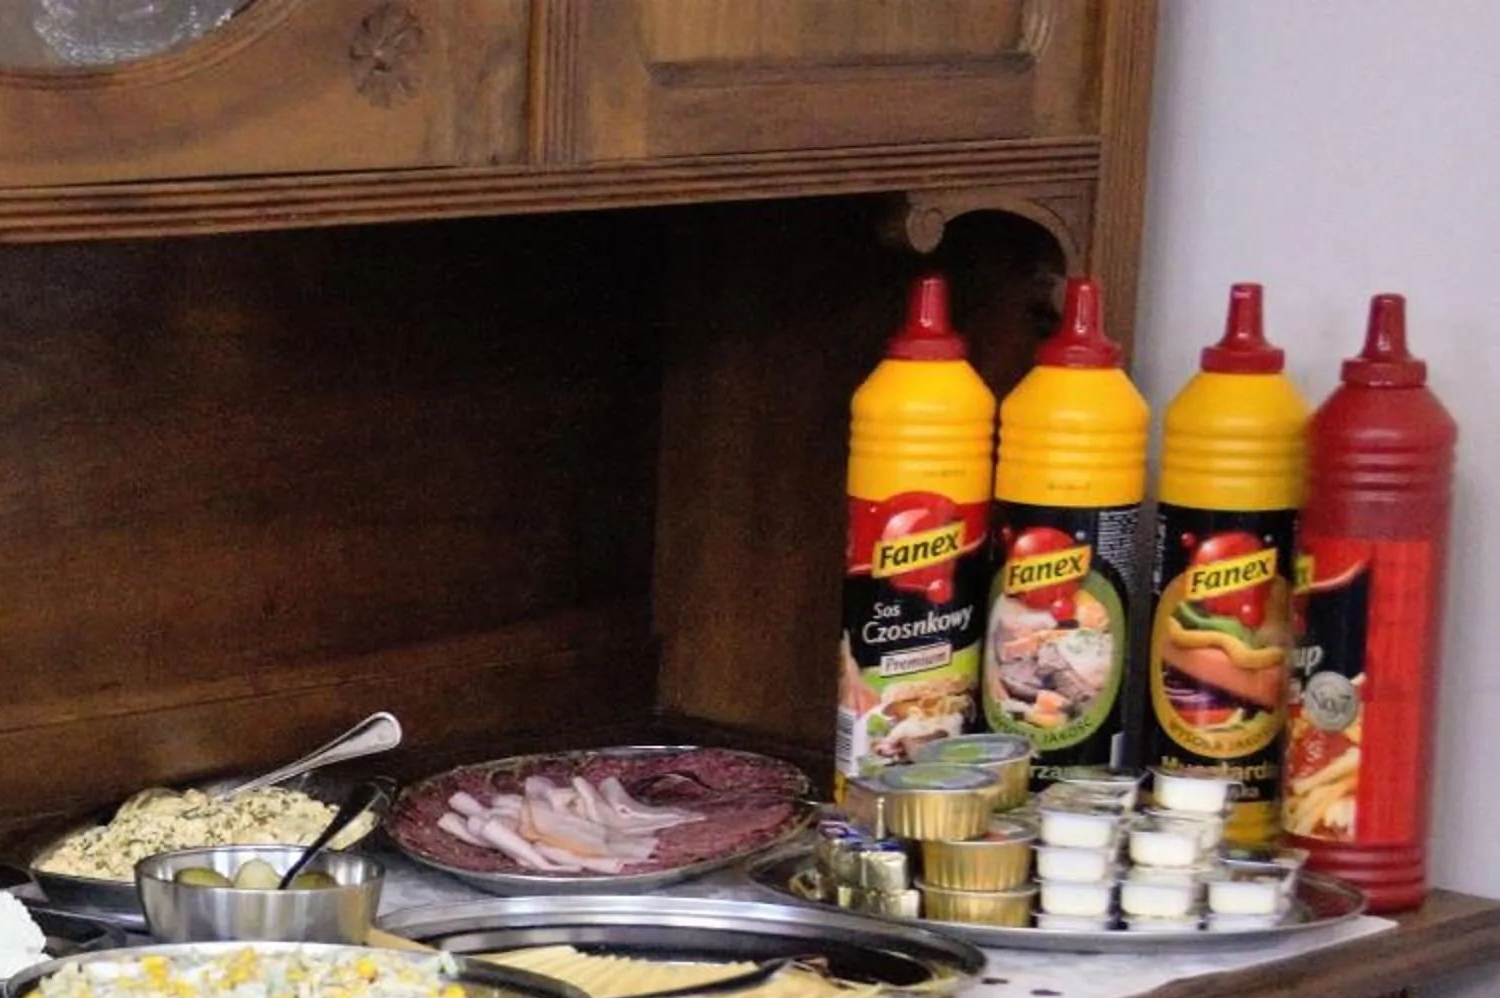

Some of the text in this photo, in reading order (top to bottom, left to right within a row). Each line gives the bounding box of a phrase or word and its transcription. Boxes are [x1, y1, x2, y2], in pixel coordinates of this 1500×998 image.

[879, 531, 960, 569] Fanex
[1008, 552, 1083, 587] Fanex
[1191, 557, 1272, 593] Fanex
[862, 604, 974, 644] Czosnkowy
[872, 602, 901, 619] Sos
